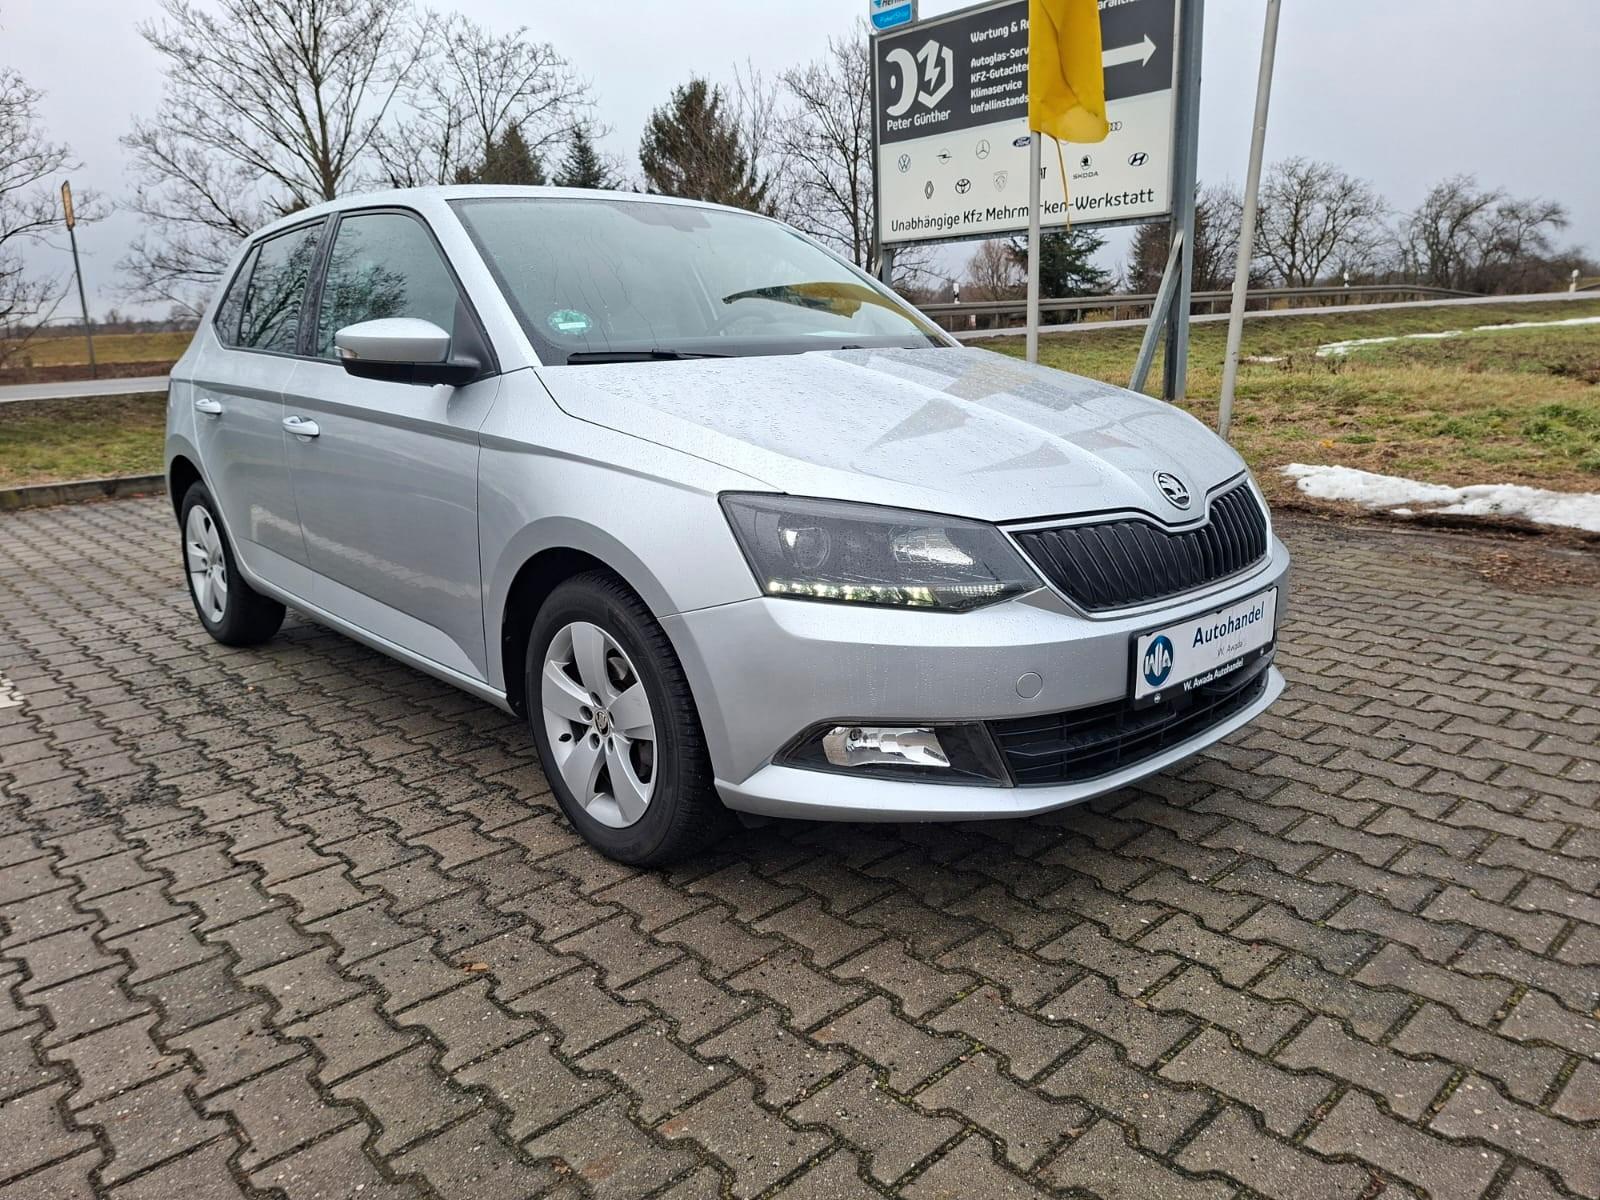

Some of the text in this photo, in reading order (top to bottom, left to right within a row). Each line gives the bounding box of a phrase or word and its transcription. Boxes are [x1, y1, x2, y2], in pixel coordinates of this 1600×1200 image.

[970, 25, 1009, 43] Wartung
[1010, 21, 1018, 33] &
[970, 47, 1029, 69] Autoglas-Serv
[970, 79, 1023, 99] Klimaservice
[970, 92, 1029, 114] Unfallinstands
[886, 109, 951, 132] Peter Günther
[891, 188, 1154, 232] Unabhängige Kfz Mehrmken-Werkstatt
[1192, 600, 1265, 648] Autohandel
[1183, 656, 1244, 692] W. Awada Autohandel
